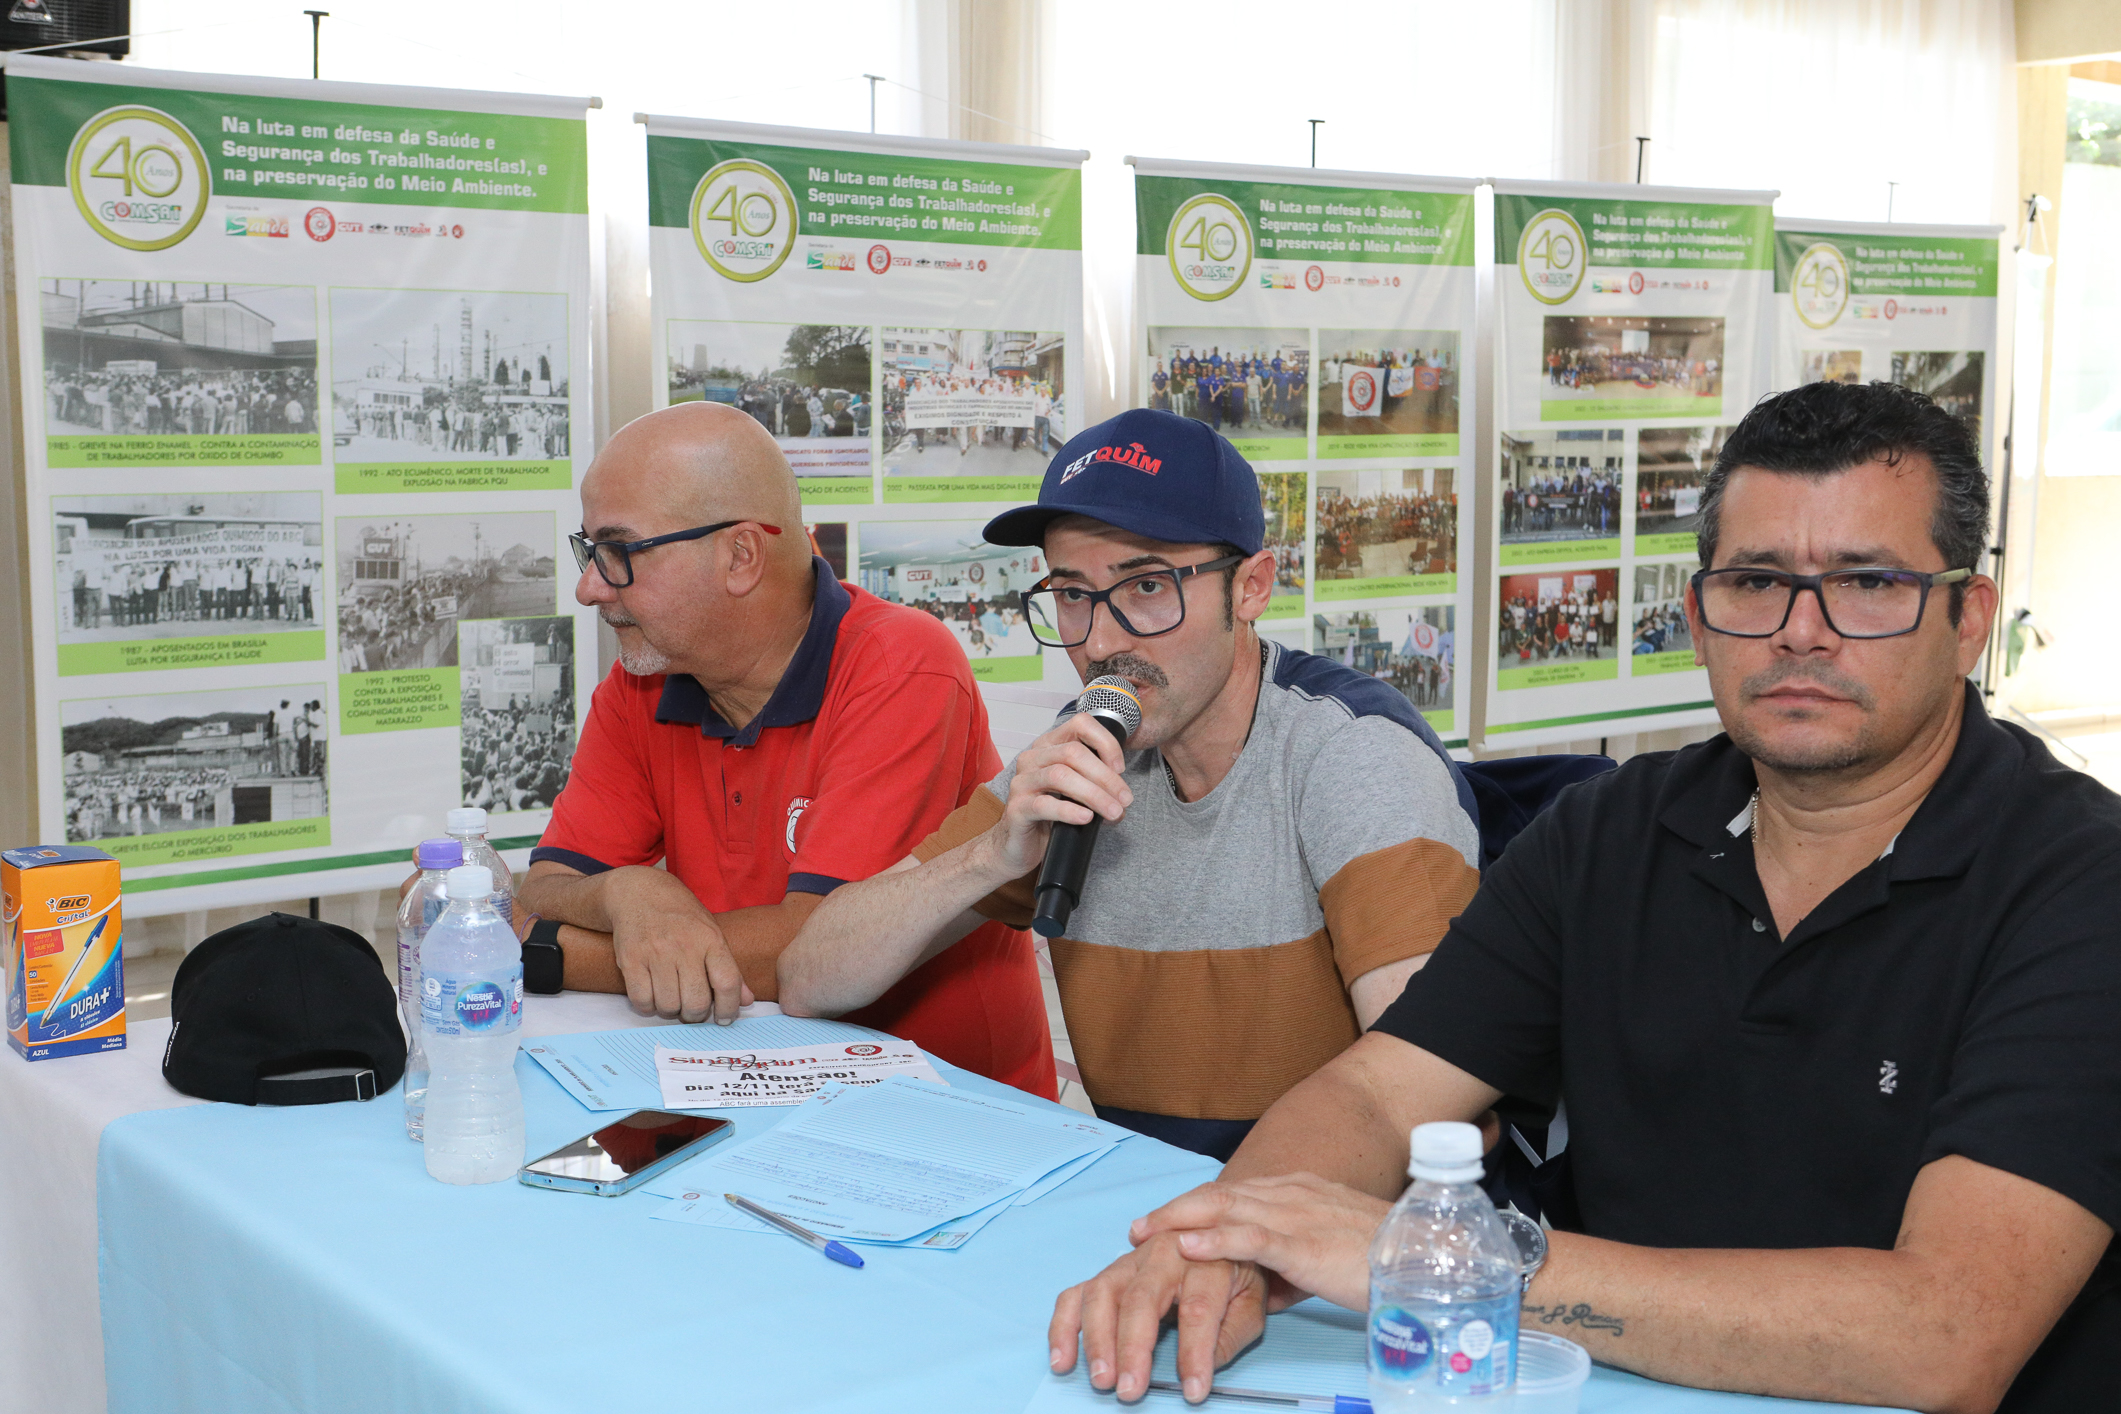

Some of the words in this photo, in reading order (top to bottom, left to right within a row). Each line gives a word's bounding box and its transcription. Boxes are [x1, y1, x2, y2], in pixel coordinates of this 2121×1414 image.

[222, 116, 249, 133] Na
[257, 118, 295, 137] luta
[302, 125, 328, 139] em
[335, 124, 393, 146] defesa
[400, 129, 420, 145] da
[427, 130, 480, 149] Saúde
[486, 138, 495, 150] e
[222, 140, 323, 166] Segurança
[330, 148, 362, 164] dos
[368, 150, 532, 177] Trabalhadores(as),
[538, 164, 548, 175] e
[90, 137, 183, 198] 40
[224, 169, 247, 182] na
[254, 170, 368, 192] preservação
[374, 174, 396, 190] do
[402, 175, 446, 193] Meio
[452, 178, 537, 197] Ambiente.
[808, 167, 829, 182] Na
[834, 169, 863, 185] luta
[867, 175, 888, 187] em
[892, 174, 937, 190] defesa
[942, 176, 958, 191] da
[962, 178, 1002, 195] Saúde
[1006, 184, 1014, 195] e
[808, 188, 884, 209] Segurança
[888, 193, 914, 208] dos
[917, 195, 1040, 218] Trabalhadores(as),
[1043, 207, 1051, 217] e
[1260, 199, 1276, 212] Na
[1279, 200, 1302, 213] luta
[1305, 203, 1322, 214] em
[1325, 203, 1361, 216] defesa
[1364, 205, 1377, 217] da
[1379, 206, 1413, 219] Saúde
[1415, 209, 1421, 219] e
[100, 201, 182, 224] COMSAT
[707, 185, 777, 237] 40
[808, 211, 825, 222] na
[830, 212, 917, 231] preservação
[921, 216, 938, 230] do
[942, 217, 975, 232] Meio
[978, 219, 1042, 236] Ambiente.
[1260, 217, 1319, 234] Segurança
[1322, 220, 1342, 233] dos
[1180, 216, 1237, 261] 40
[1260, 237, 1273, 247] na
[1276, 237, 1346, 253] preservação
[1348, 239, 1361, 251] do
[1364, 240, 1390, 252] Meio
[713, 239, 774, 259] COMSAT
[1529, 229, 1574, 269] 40
[200, 440, 231, 449] CONTRA
[101, 451, 175, 461] TRABALHADORES
[244, 450, 284, 459] CHUMBO
[359, 469, 378, 477] 1992
[386, 469, 402, 477] ATO
[456, 467, 482, 476] MORTE
[484, 467, 494, 475] DE
[496, 466, 550, 475] TRABALHADOR
[403, 477, 443, 487] EXPLOSÃO
[834, 485, 869, 493] ACIDENTES
[150, 641, 215, 654] APOSENTADOS
[218, 641, 230, 649] EM
[126, 657, 148, 666] LUTA
[149, 656, 168, 664] POR
[170, 652, 223, 663] SEGURANÇA
[365, 677, 384, 686] 1992
[391, 675, 431, 684] PROTESTO
[354, 688, 389, 697] CONTRA
[397, 683, 441, 694] EXPOSIÇÃO
[352, 699, 371, 708] DOS
[373, 694, 437, 706] TRABALHADORES
[346, 706, 403, 718] COMUNIDADE
[405, 705, 418, 713] AO
[420, 704, 436, 713] BHC
[438, 703, 450, 711] DA
[375, 715, 423, 726] MATARAZZO
[111, 843, 139, 855] GREVE
[176, 834, 225, 847] EXPOSIÇÃO
[228, 832, 246, 842] DOS
[248, 825, 317, 840] TRABALHADORES
[171, 850, 185, 858] AO
[33, 932, 53, 941] NOVA
[33, 942, 55, 952] NUEVA
[466, 992, 494, 1003] Nestlé
[32, 1048, 51, 1057] AZUL
[740, 1071, 858, 1083] Atenção!
[721, 1082, 770, 1090] 12/11
[778, 1081, 814, 1090] terá
